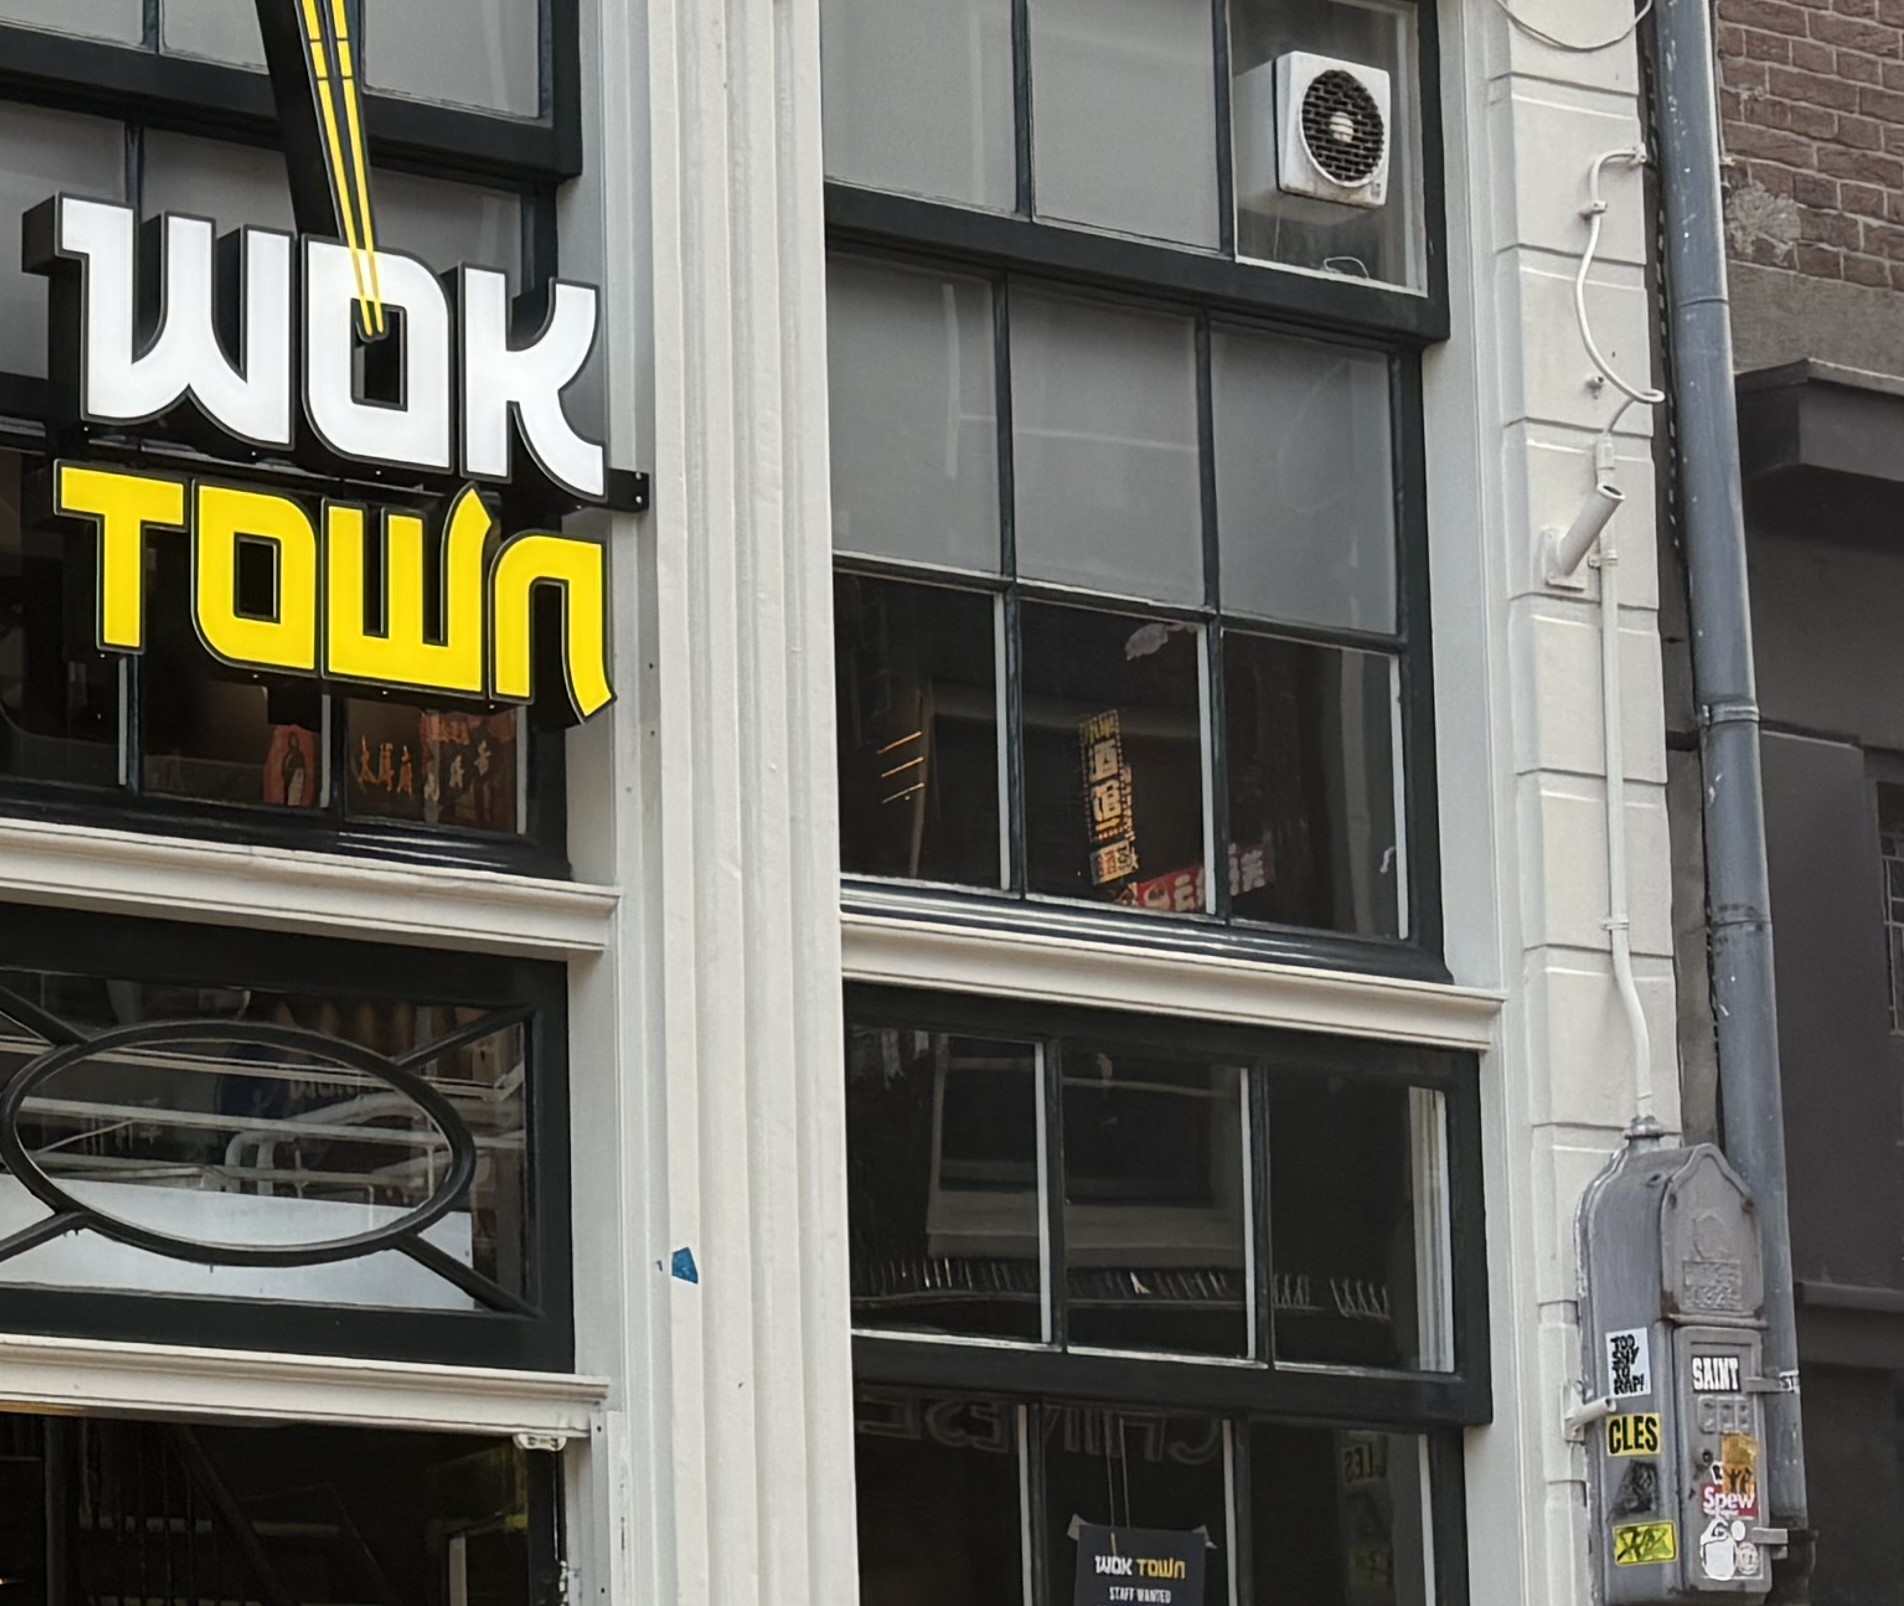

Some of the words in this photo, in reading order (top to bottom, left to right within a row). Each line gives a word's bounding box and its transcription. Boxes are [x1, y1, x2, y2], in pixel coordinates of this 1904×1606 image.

[56, 191, 606, 501] WOK
[55, 458, 616, 724] TOWN
[1610, 1333, 1636, 1350] TOO
[1693, 1356, 1739, 1391] SAINT
[1608, 1415, 1658, 1454] CLES
[1703, 1486, 1755, 1515] Spew
[1095, 1555, 1132, 1575] WOK
[1136, 1557, 1185, 1579] TOWN
[1109, 1586, 1135, 1601] STAFF
[1137, 1588, 1171, 1603] WANTED
